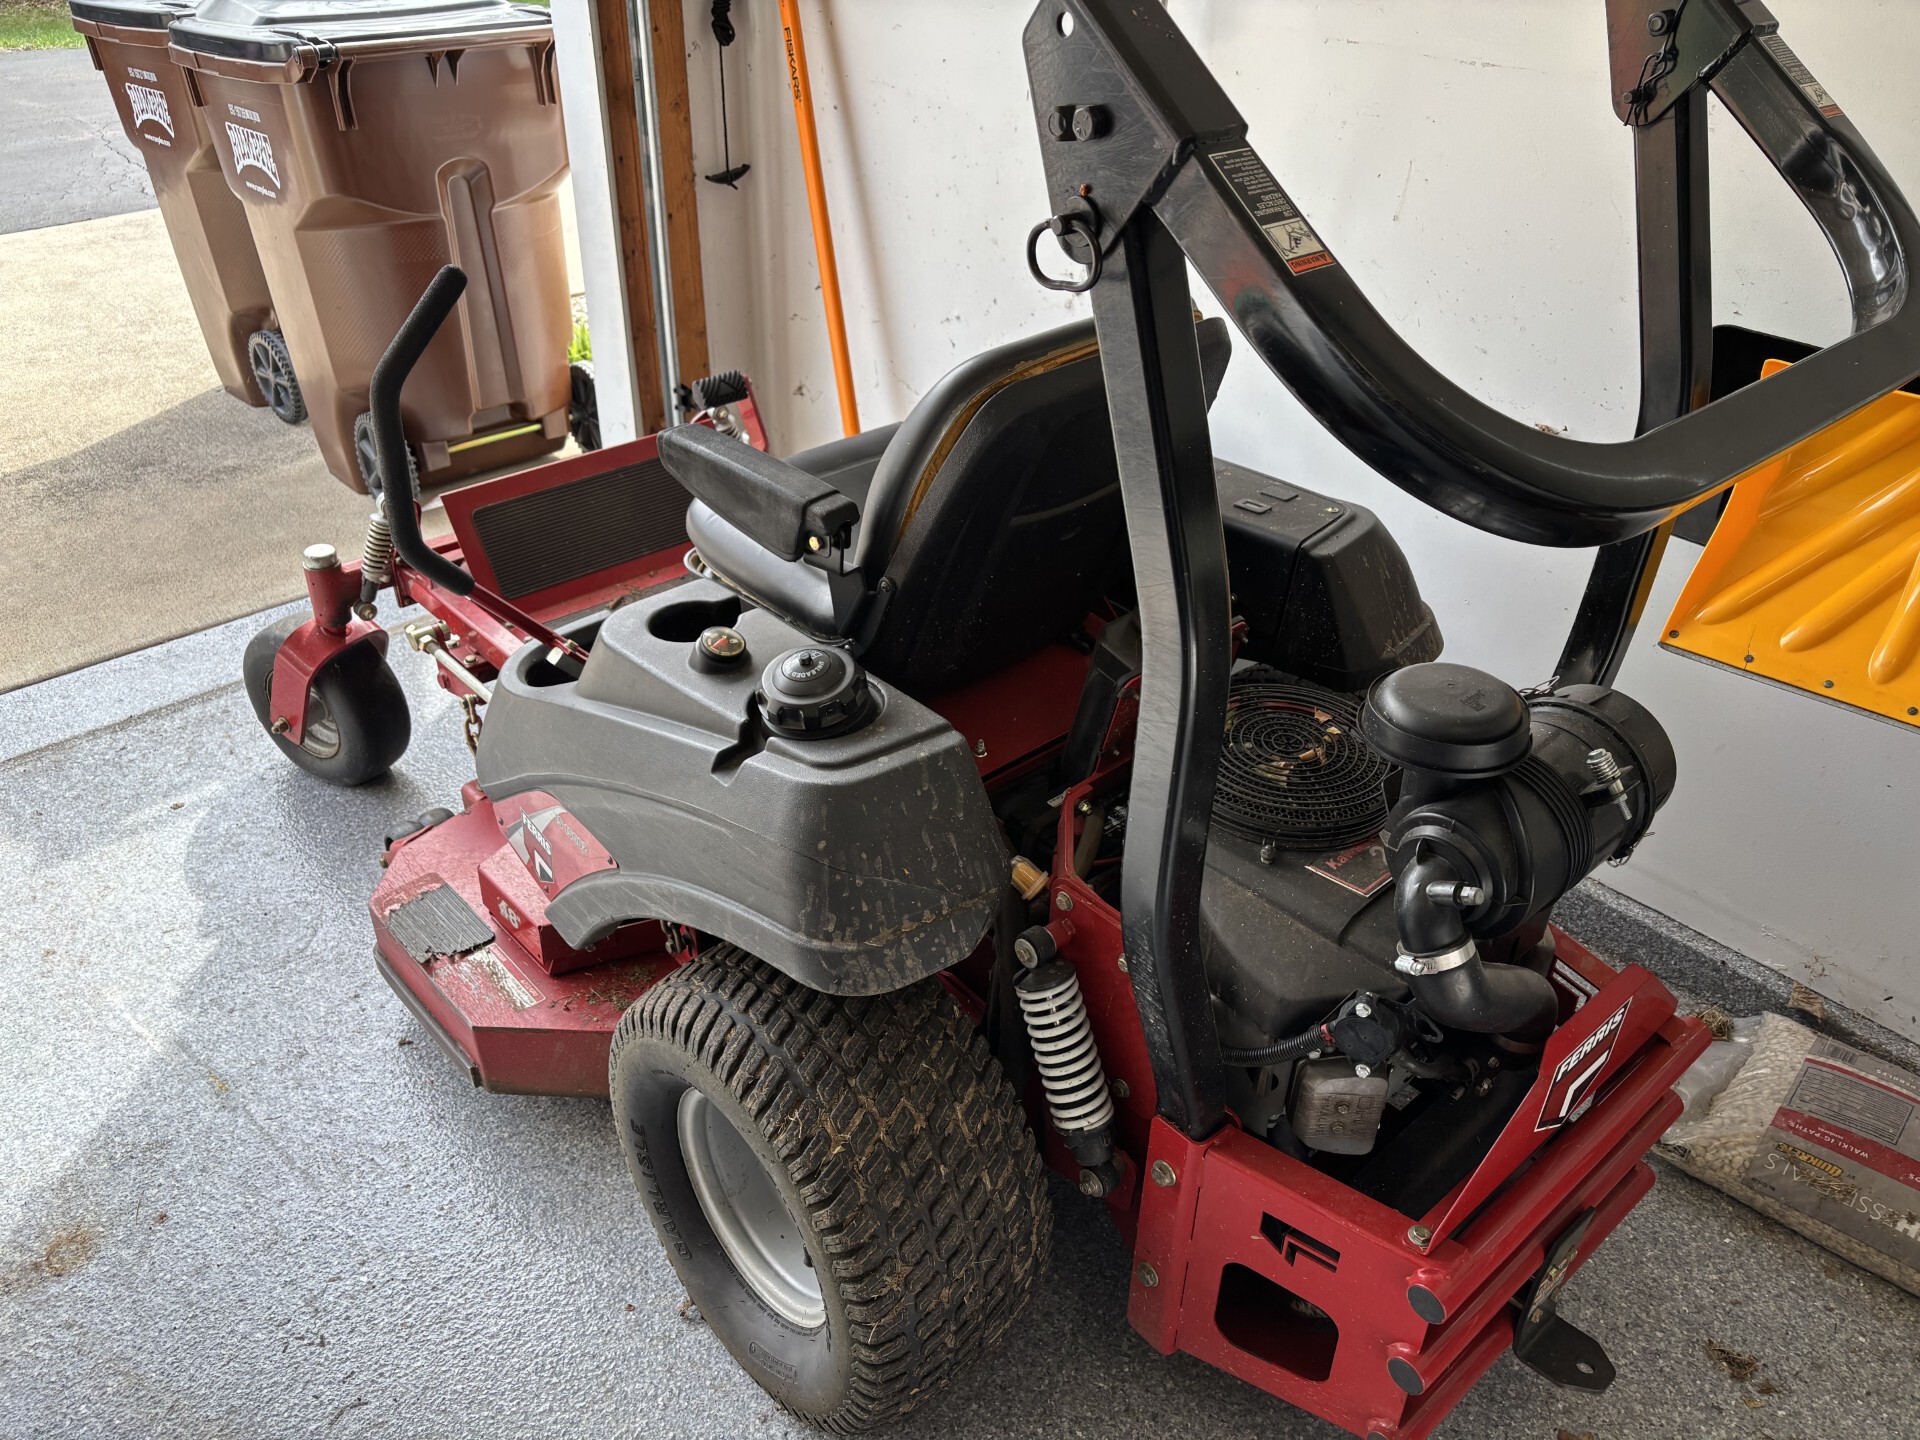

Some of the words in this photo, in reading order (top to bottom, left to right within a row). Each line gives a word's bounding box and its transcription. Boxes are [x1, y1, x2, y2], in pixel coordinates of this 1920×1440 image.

[784, 26, 801, 100] FISKARS
[1290, 254, 1320, 269] WARNING
[791, 660, 825, 678] UNLEADED
[522, 812, 552, 856] FERRIS
[1555, 1007, 1625, 1083] FERRIS
[629, 1118, 692, 1260] CARLISLE
